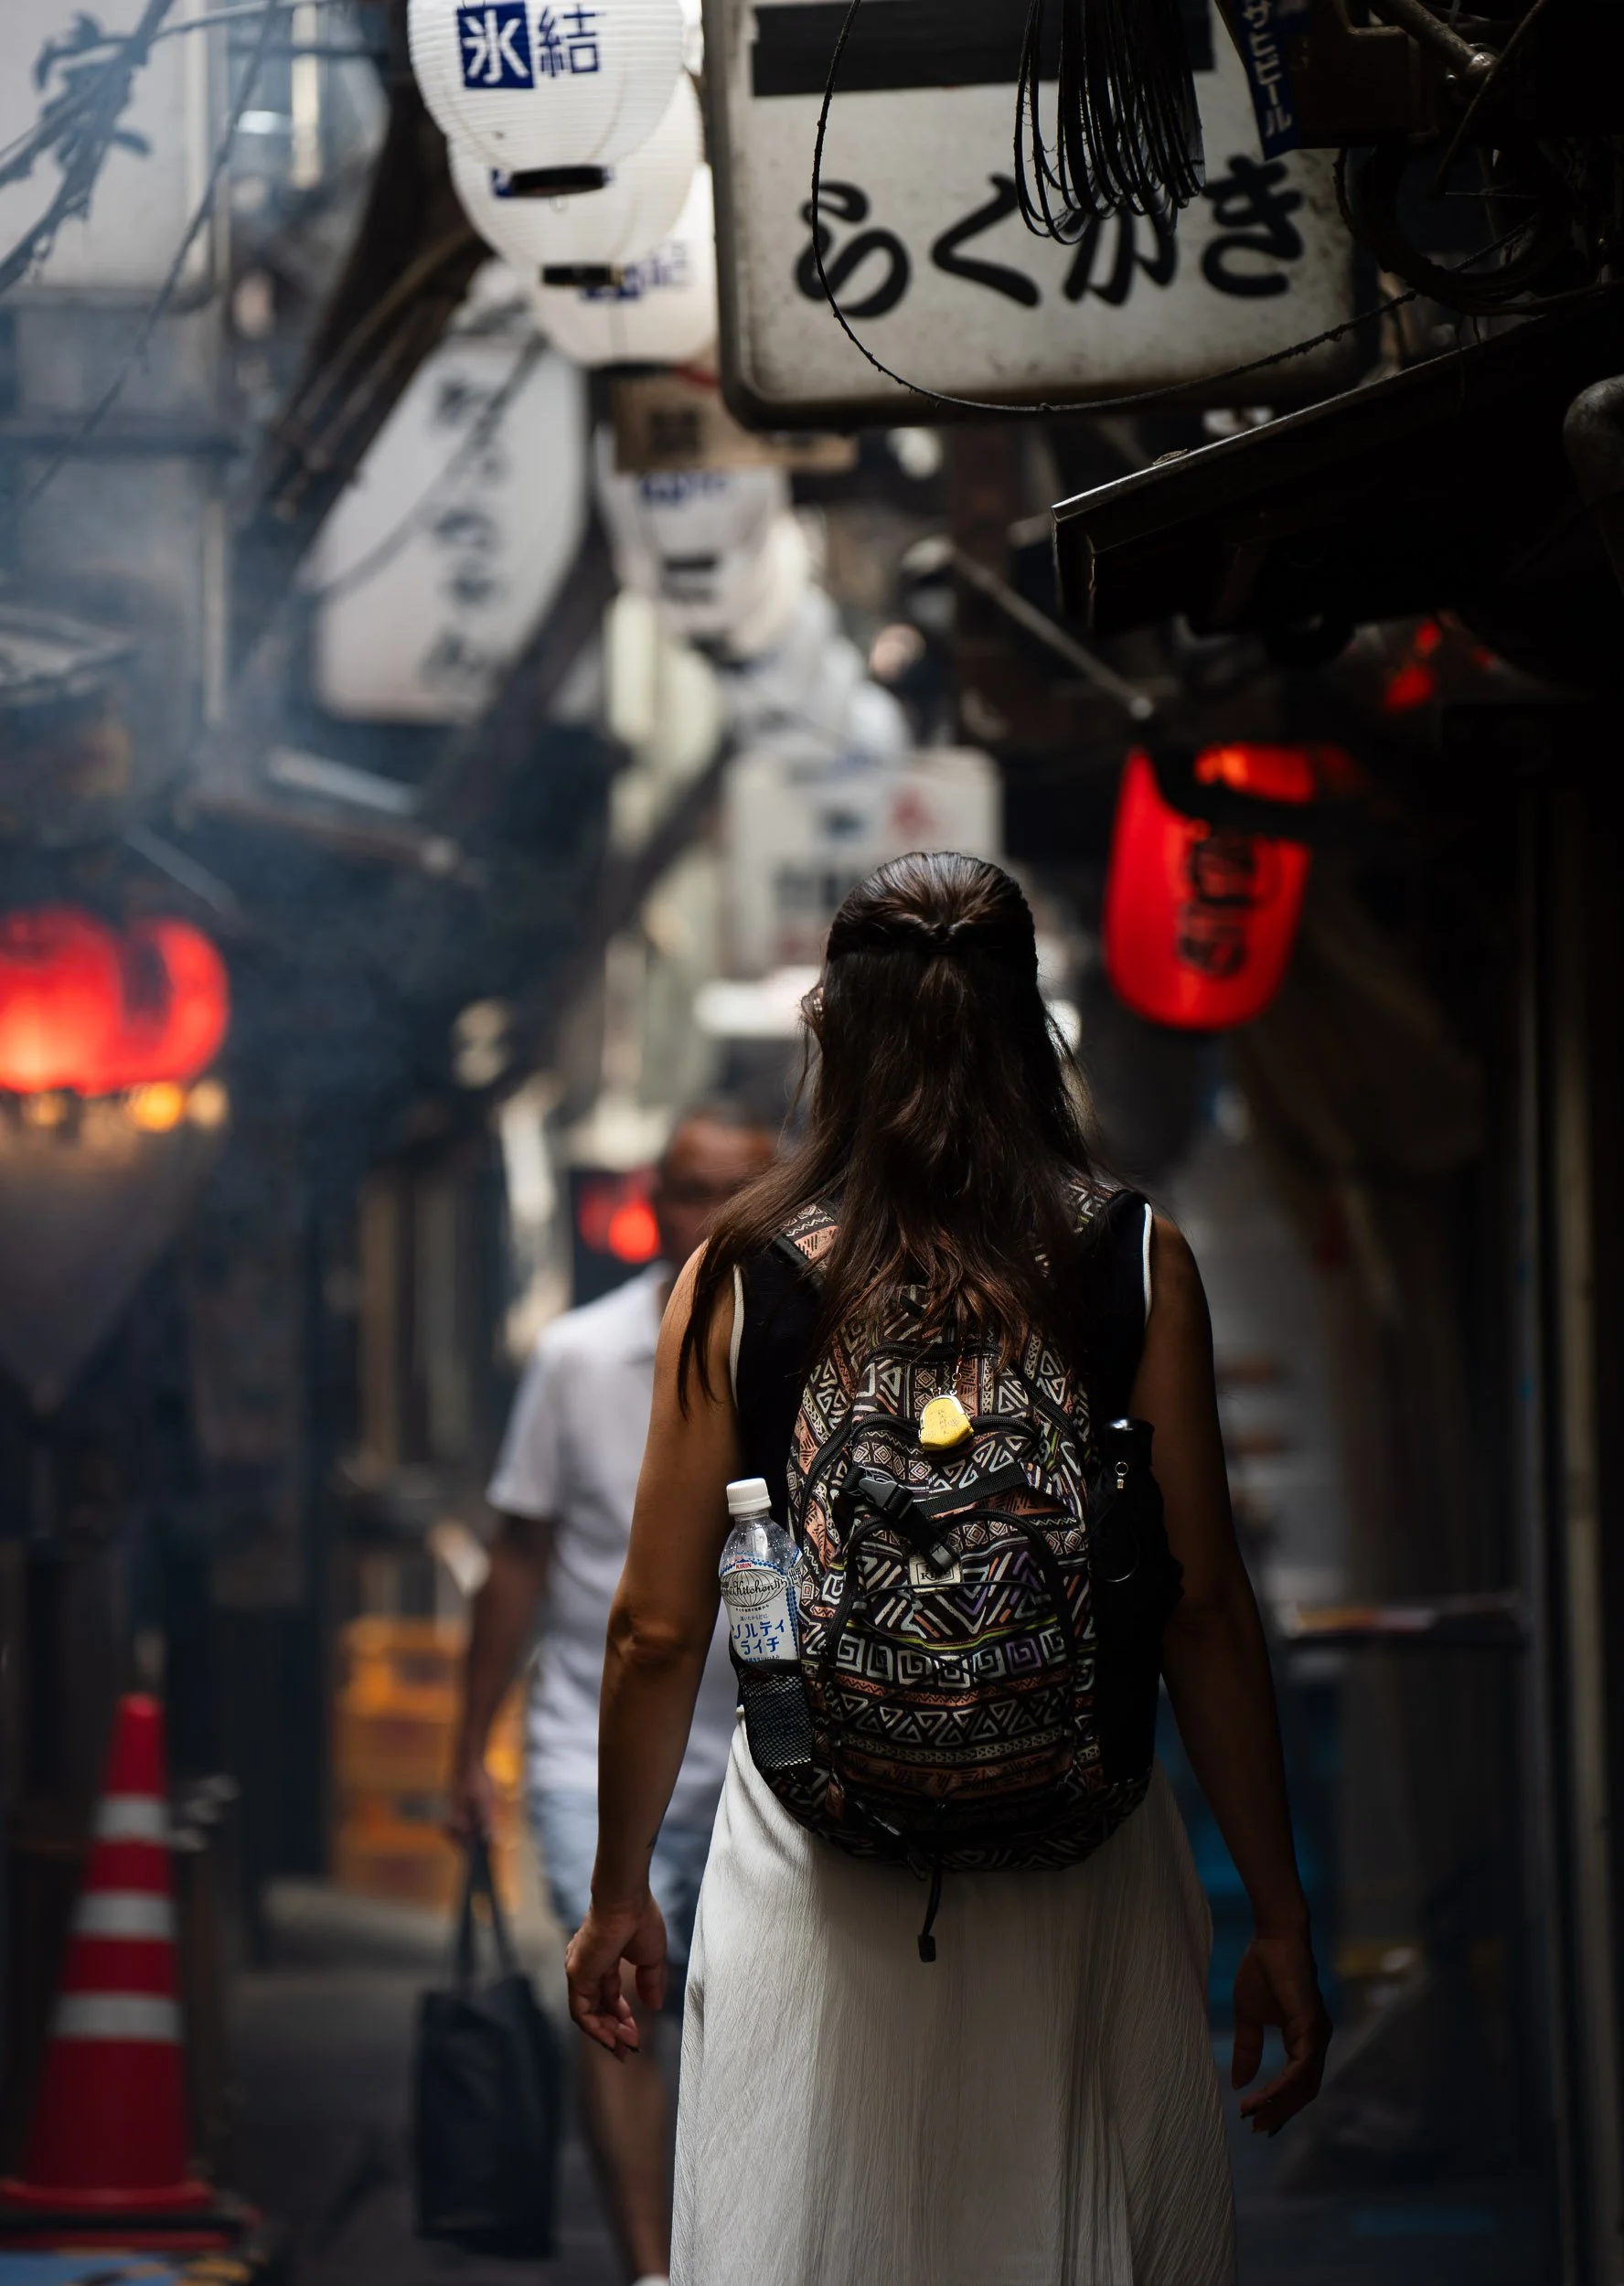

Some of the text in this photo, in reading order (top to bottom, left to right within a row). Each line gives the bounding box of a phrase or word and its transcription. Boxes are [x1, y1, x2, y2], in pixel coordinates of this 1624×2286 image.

[462, 4, 601, 85] 氷結
[731, 1618, 785, 1640] ソルティ
[741, 1636, 780, 1655] ライチ
